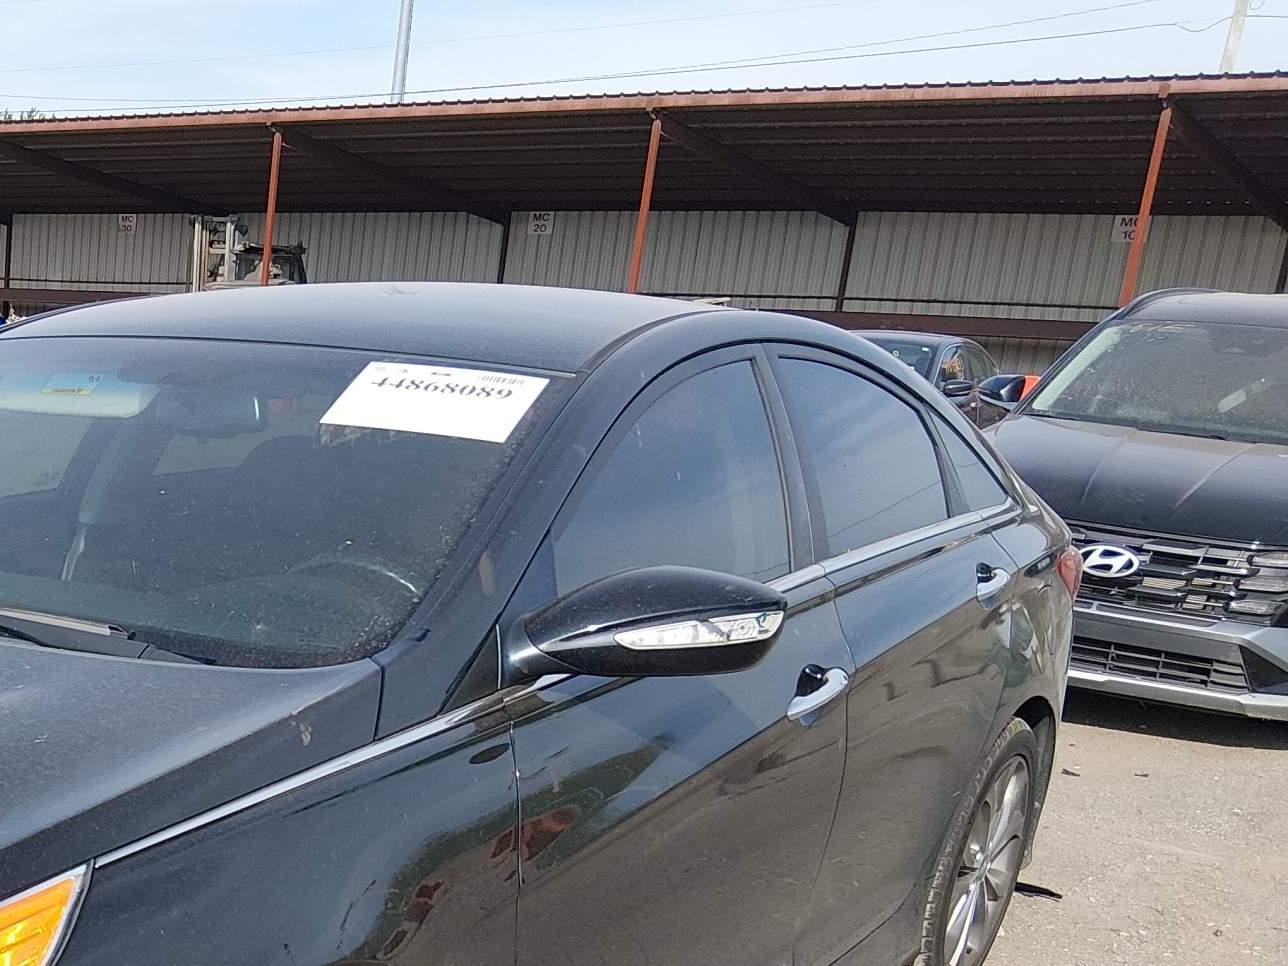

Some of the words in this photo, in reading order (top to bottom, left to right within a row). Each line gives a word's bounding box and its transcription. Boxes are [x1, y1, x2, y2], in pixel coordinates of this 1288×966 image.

[121, 215, 134, 223] MC
[533, 212, 550, 222] MC
[533, 223, 547, 233] 20
[370, 376, 514, 399] 44868089
